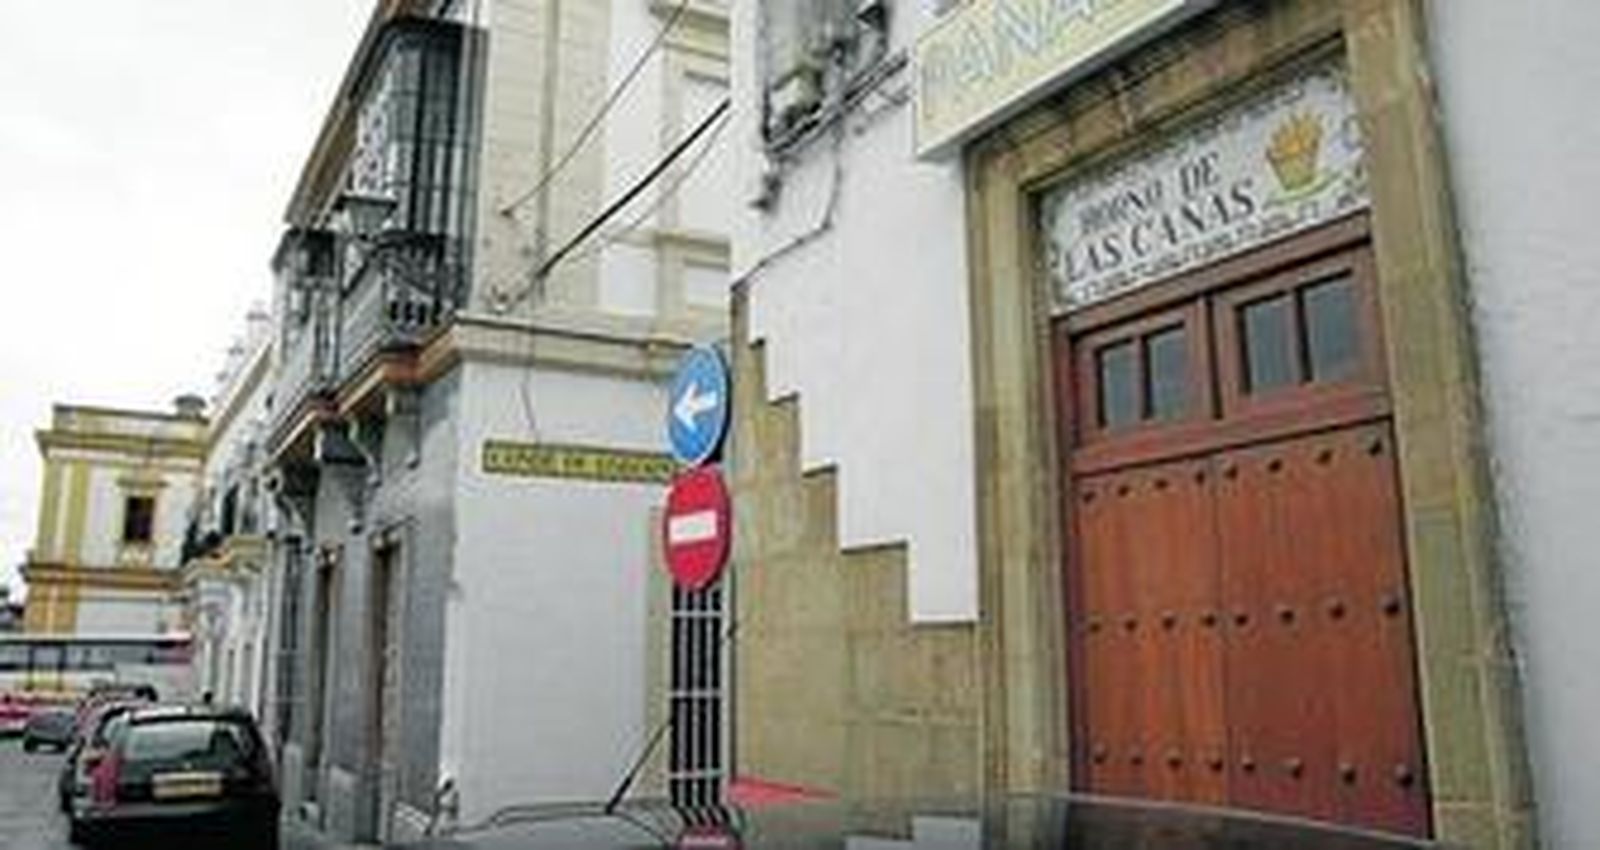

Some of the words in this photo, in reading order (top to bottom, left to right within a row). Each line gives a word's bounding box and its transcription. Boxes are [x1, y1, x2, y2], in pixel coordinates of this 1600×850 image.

[921, 0, 1102, 119] PANA
[1179, 150, 1221, 199] DE
[1064, 229, 1123, 283] LAS
